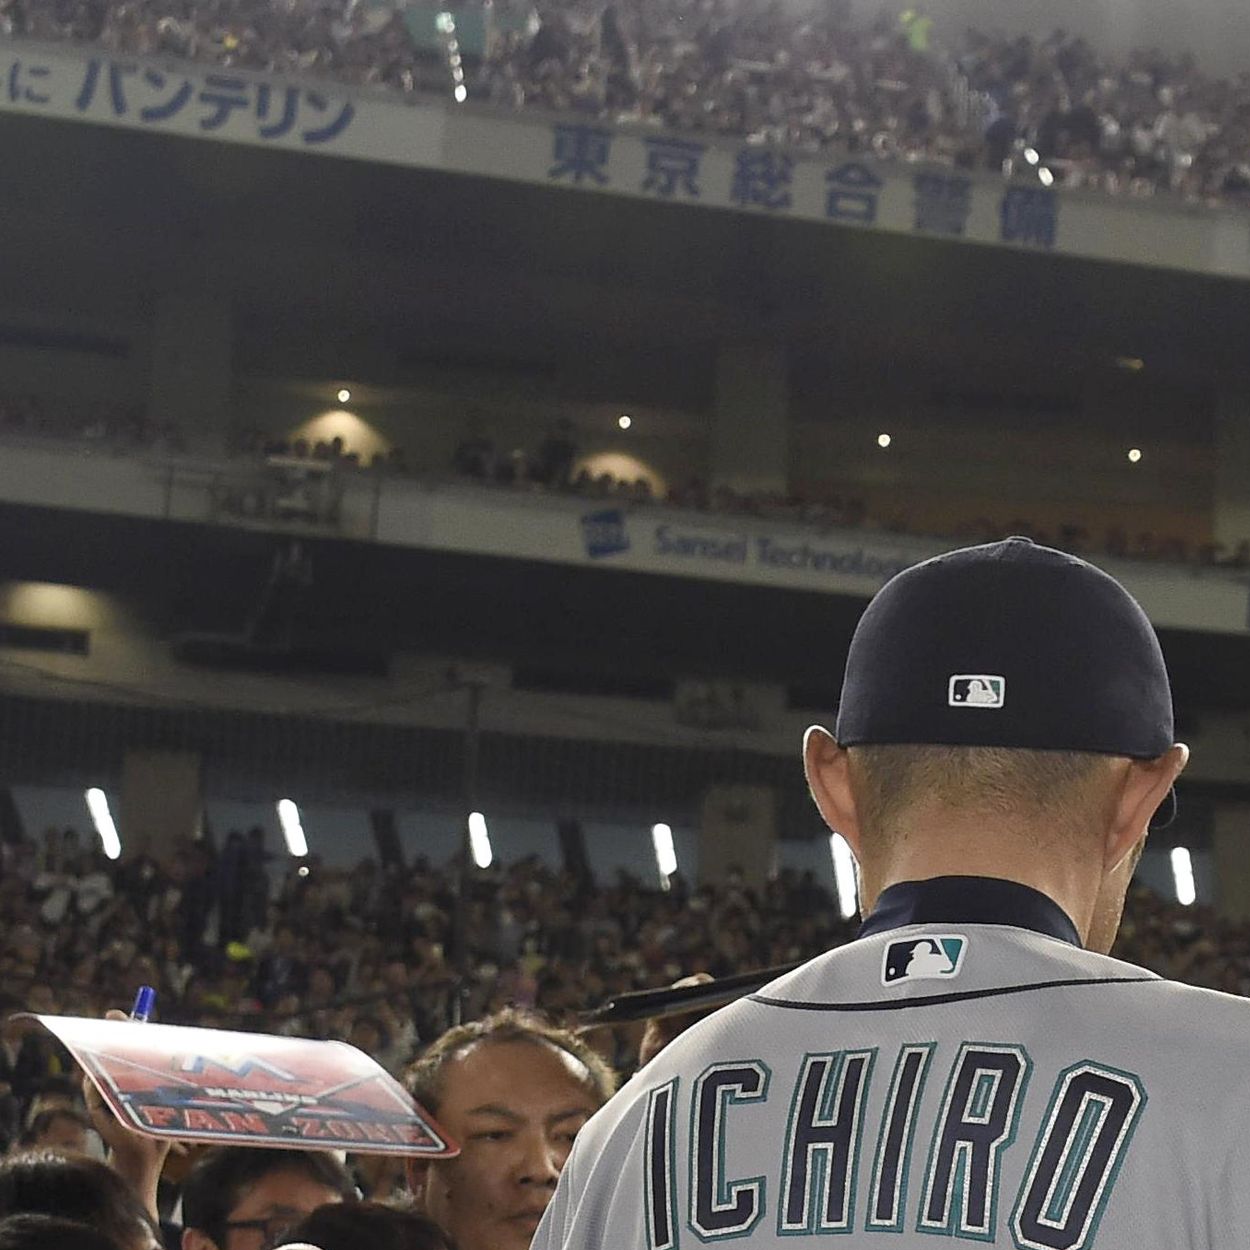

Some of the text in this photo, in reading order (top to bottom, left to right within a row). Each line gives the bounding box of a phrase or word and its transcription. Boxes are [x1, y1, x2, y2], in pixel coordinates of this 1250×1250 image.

[76, 57, 356, 144] バンテリン
[139, 1104, 430, 1147] FAN ZONE
